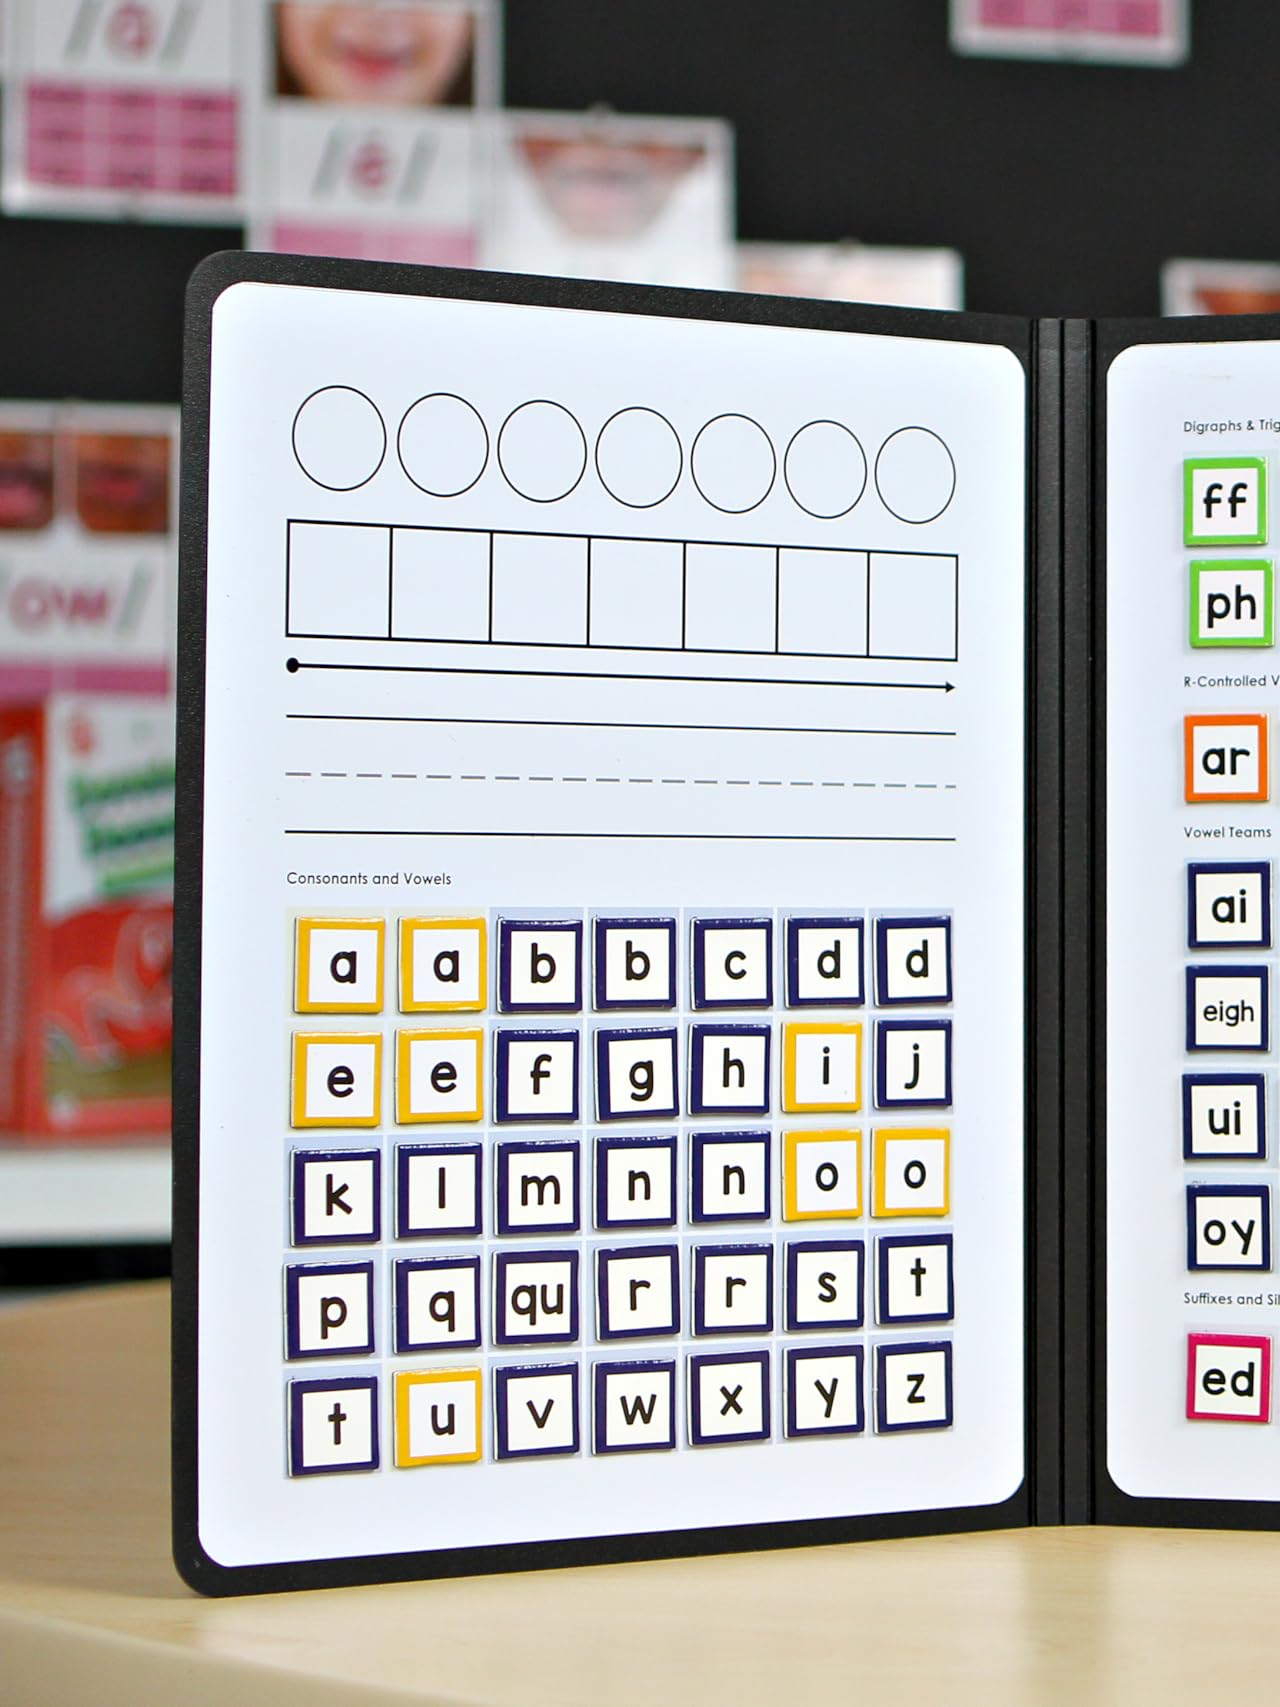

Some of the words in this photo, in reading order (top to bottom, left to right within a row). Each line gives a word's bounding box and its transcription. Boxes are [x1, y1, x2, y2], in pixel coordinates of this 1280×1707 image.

[1183, 420, 1242, 435] Digraphs
[1246, 420, 1255, 431] &
[1203, 482, 1248, 519] ff
[1207, 584, 1257, 629] ph
[1184, 675, 1267, 688] R-Controlled
[1202, 747, 1251, 776] ar
[1183, 826, 1225, 838] Vowel
[1229, 826, 1272, 838] Teams
[286, 871, 368, 885] Consonants
[372, 872, 399, 885] and
[403, 872, 452, 885] Vowels
[1211, 888, 1247, 924] ai
[330, 950, 357, 984] a
[433, 950, 460, 983] a
[530, 942, 557, 984] b
[625, 940, 651, 981] b
[724, 950, 747, 980] c
[817, 939, 841, 979] d
[905, 939, 929, 978] d
[1203, 999, 1254, 1027] eigh
[327, 1065, 355, 1098] e
[430, 1061, 458, 1094] e
[530, 1053, 553, 1095] f
[629, 1060, 654, 1102] g
[722, 1047, 745, 1088] h
[822, 1046, 830, 1085] i
[904, 1043, 920, 1090] j
[1208, 1100, 1241, 1136] ui
[326, 1173, 353, 1216] k
[521, 1174, 561, 1207] m
[628, 1170, 651, 1201] n
[723, 1164, 745, 1196] n
[815, 1162, 839, 1192] o
[903, 1160, 927, 1189] o
[1203, 1219, 1255, 1256] oy
[320, 1296, 348, 1340] p
[429, 1290, 456, 1333] q
[511, 1283, 564, 1326] qu
[629, 1279, 651, 1311] r
[725, 1276, 747, 1308] r
[818, 1271, 837, 1303] s
[910, 1257, 927, 1297] t
[1184, 1292, 1233, 1305] Suffixes
[1236, 1293, 1263, 1305] and
[1202, 1361, 1255, 1398] ed
[327, 1402, 347, 1446] t
[431, 1403, 455, 1436] u
[526, 1398, 554, 1429] v
[620, 1393, 657, 1426] w
[719, 1384, 743, 1416] x
[814, 1377, 839, 1418] y
[906, 1373, 926, 1404] z
